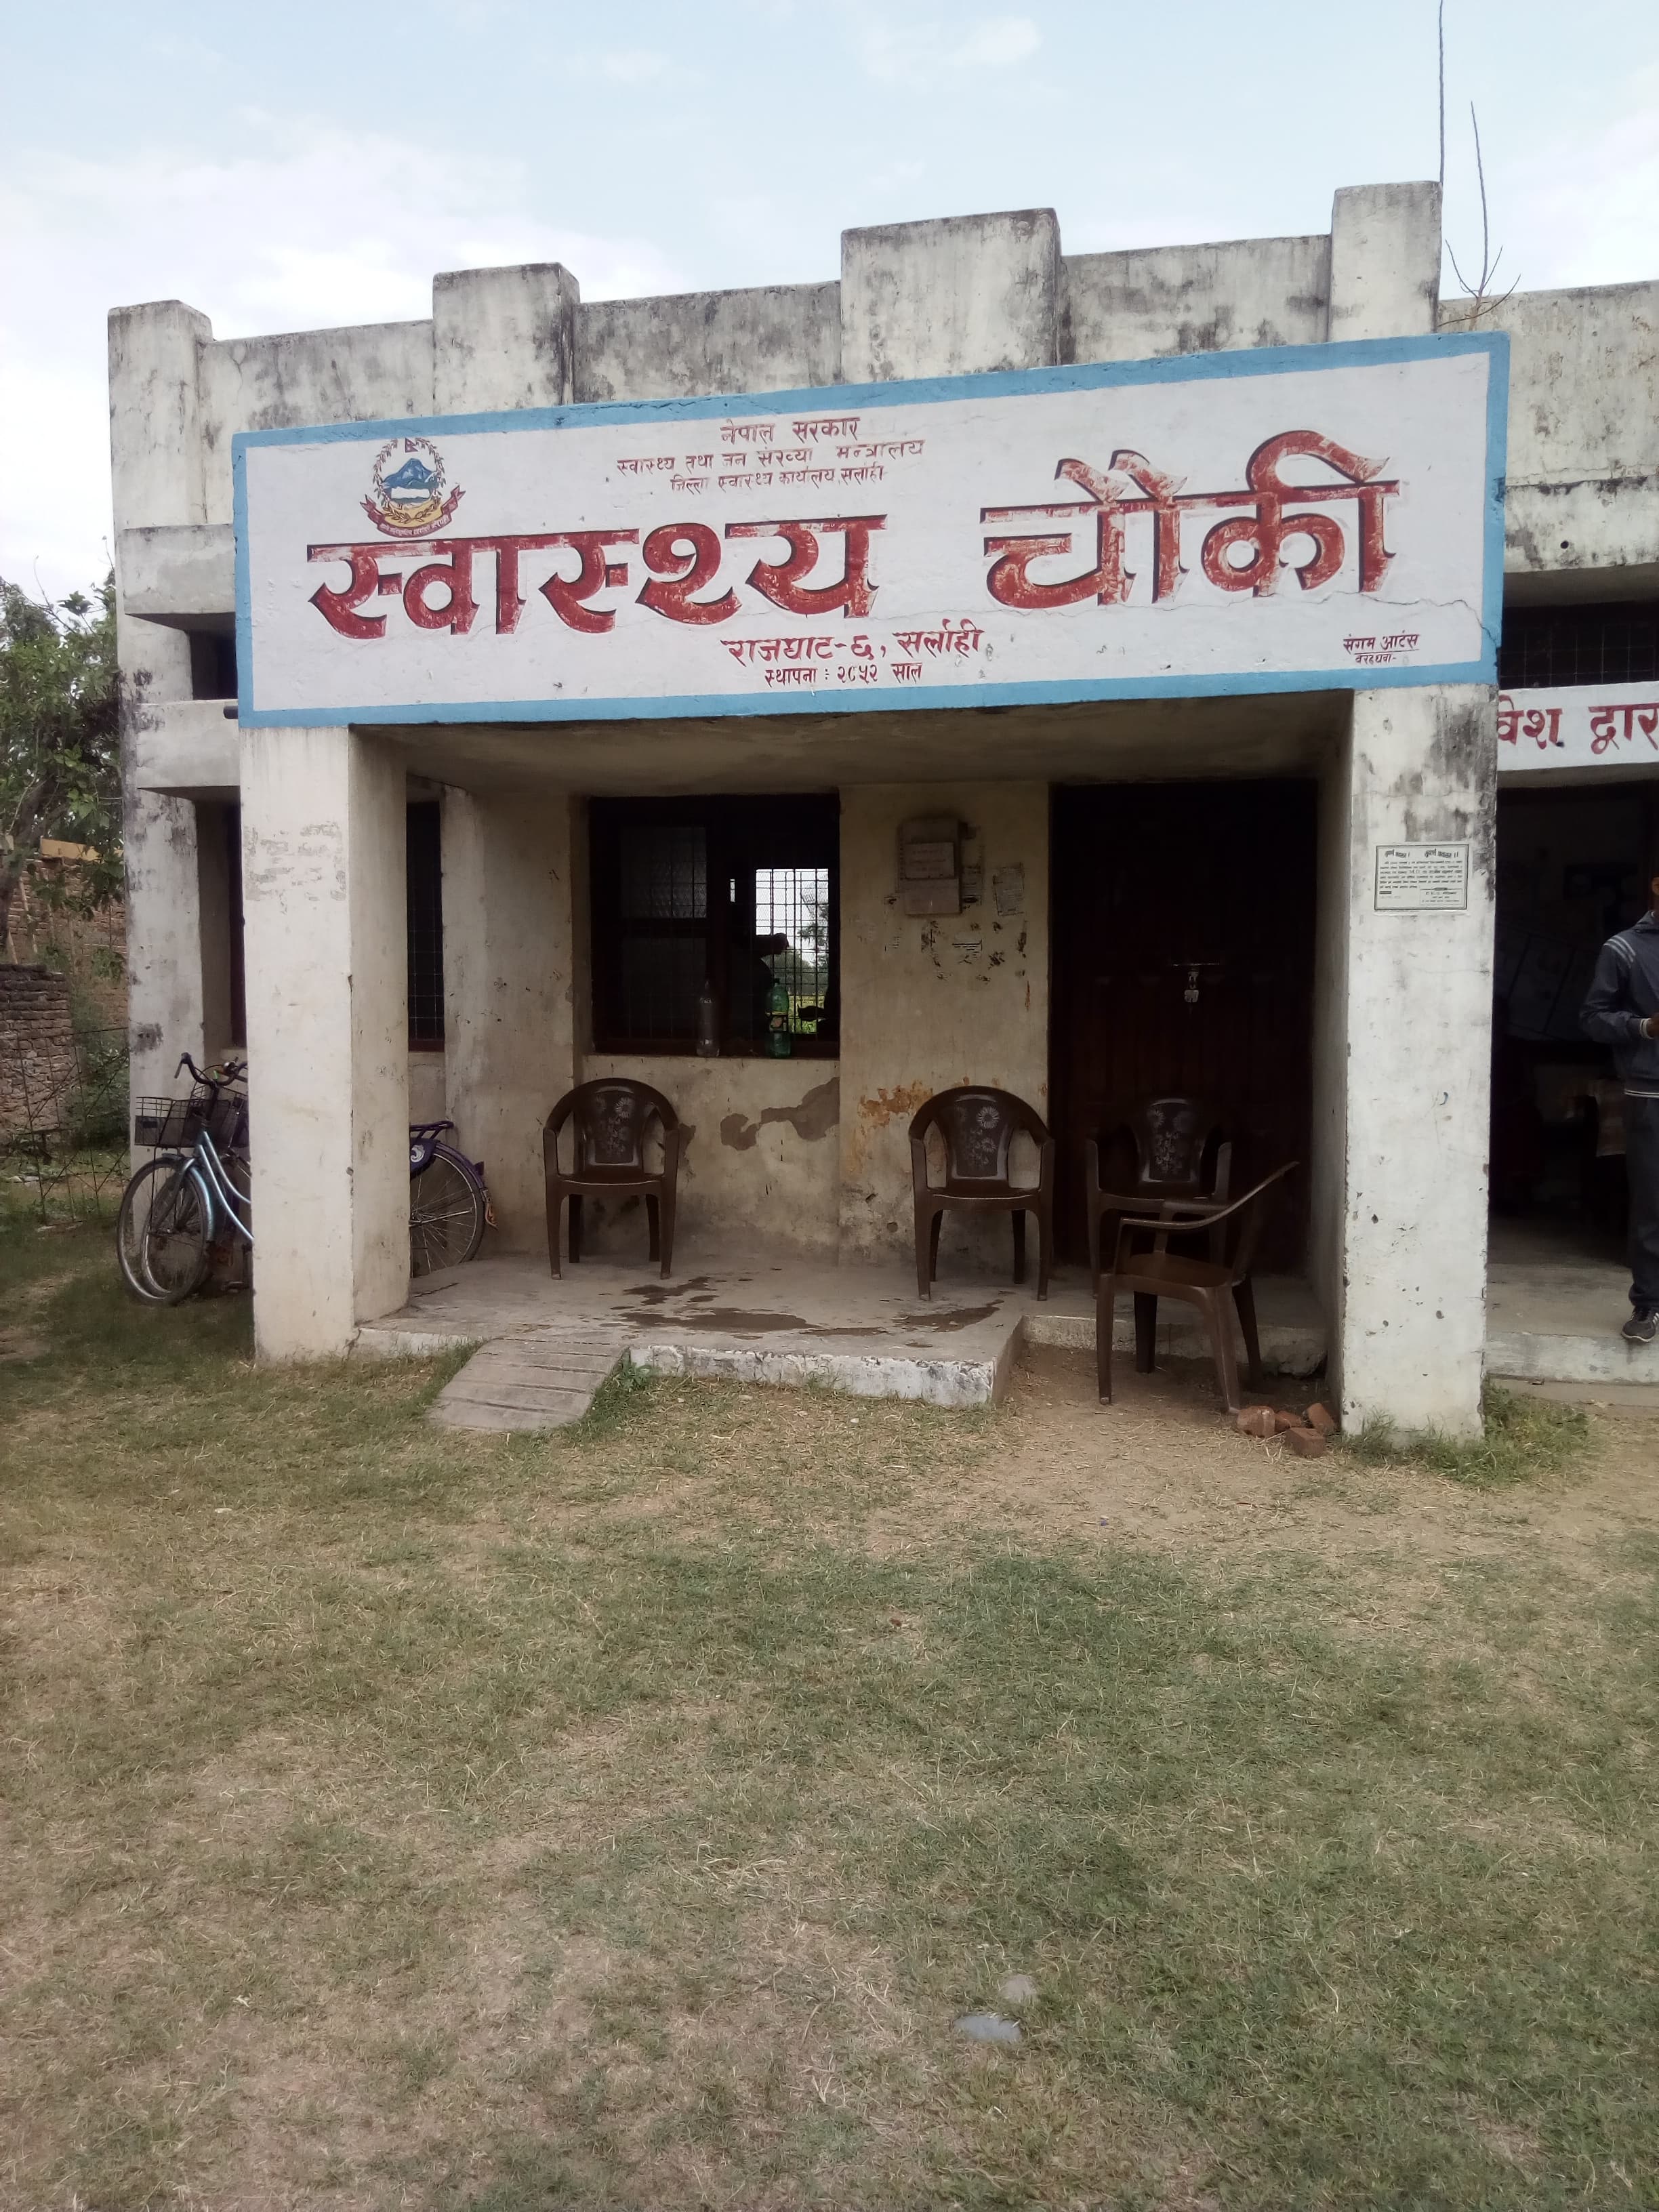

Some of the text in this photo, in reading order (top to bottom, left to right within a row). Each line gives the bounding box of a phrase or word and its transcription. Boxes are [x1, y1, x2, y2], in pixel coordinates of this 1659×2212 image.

[720, 417, 861, 445] नेपाल सरकार
[685, 454, 714, 474] तथा
[307, 430, 1400, 640] स्वास्थ्य चौकी
[764, 668, 818, 687] स्थापना
[890, 663, 923, 684] साल
